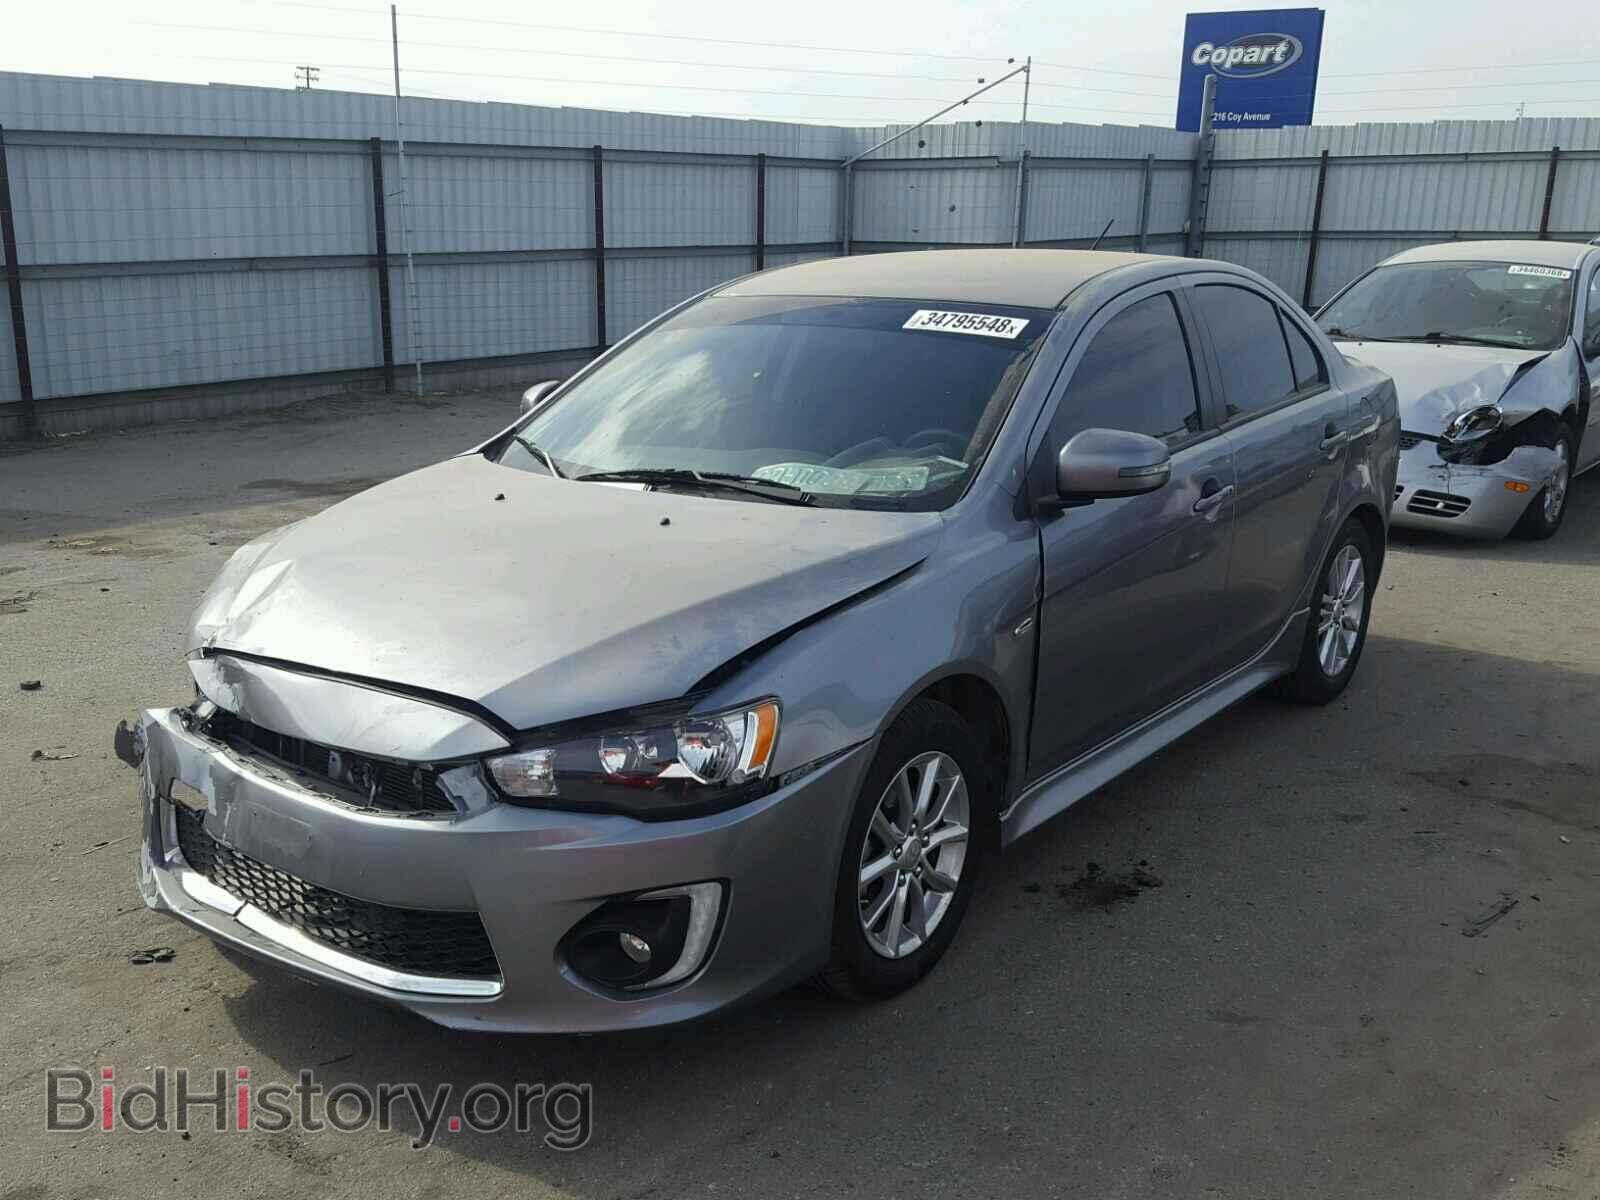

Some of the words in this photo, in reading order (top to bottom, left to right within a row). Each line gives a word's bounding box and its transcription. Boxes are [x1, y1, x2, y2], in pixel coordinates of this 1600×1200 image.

[1191, 38, 1290, 70] Copart
[1227, 111, 1242, 124] Coy
[1242, 111, 1271, 121] Avenue
